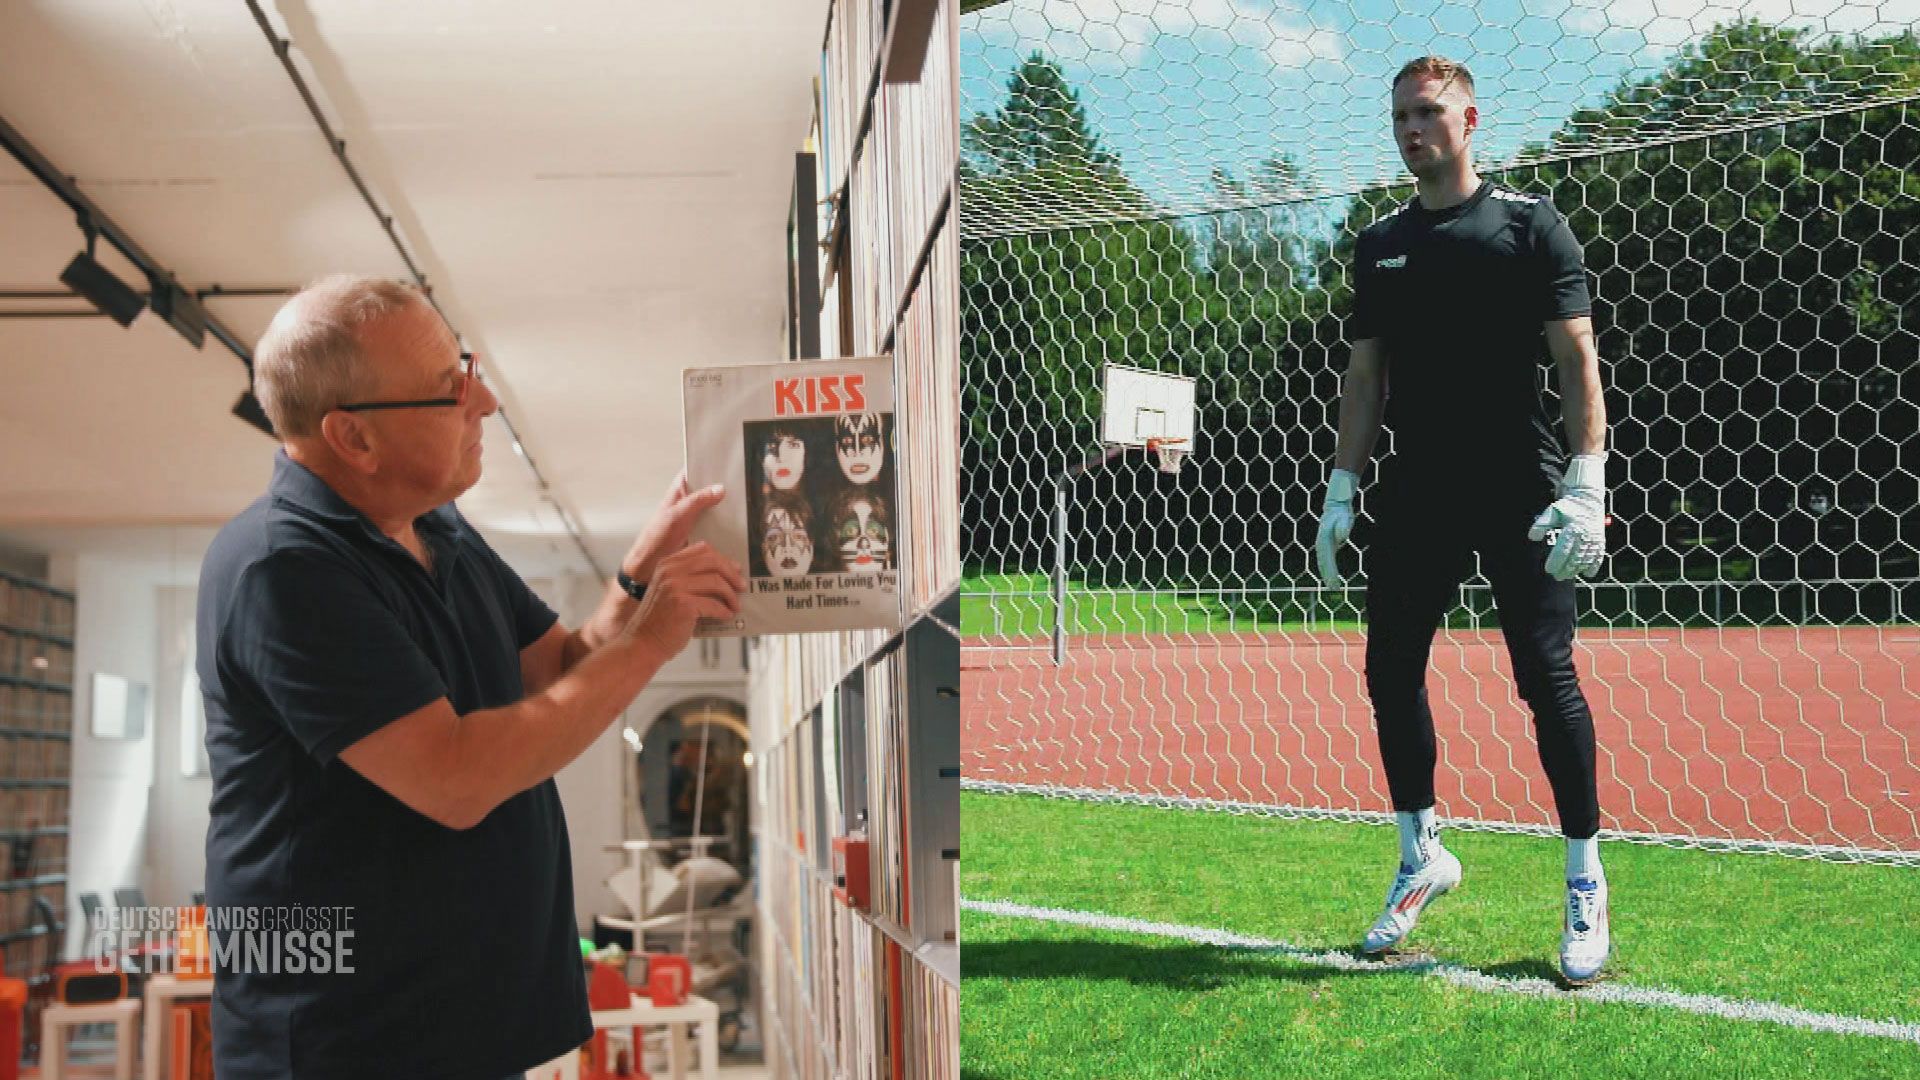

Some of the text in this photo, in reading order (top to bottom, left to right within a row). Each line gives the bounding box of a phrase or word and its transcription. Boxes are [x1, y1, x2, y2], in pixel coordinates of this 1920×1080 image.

[774, 374, 866, 416] KISS
[750, 572, 896, 593] I Was Made For Loving You
[786, 594, 812, 610] Hard
[816, 593, 849, 608] Times
